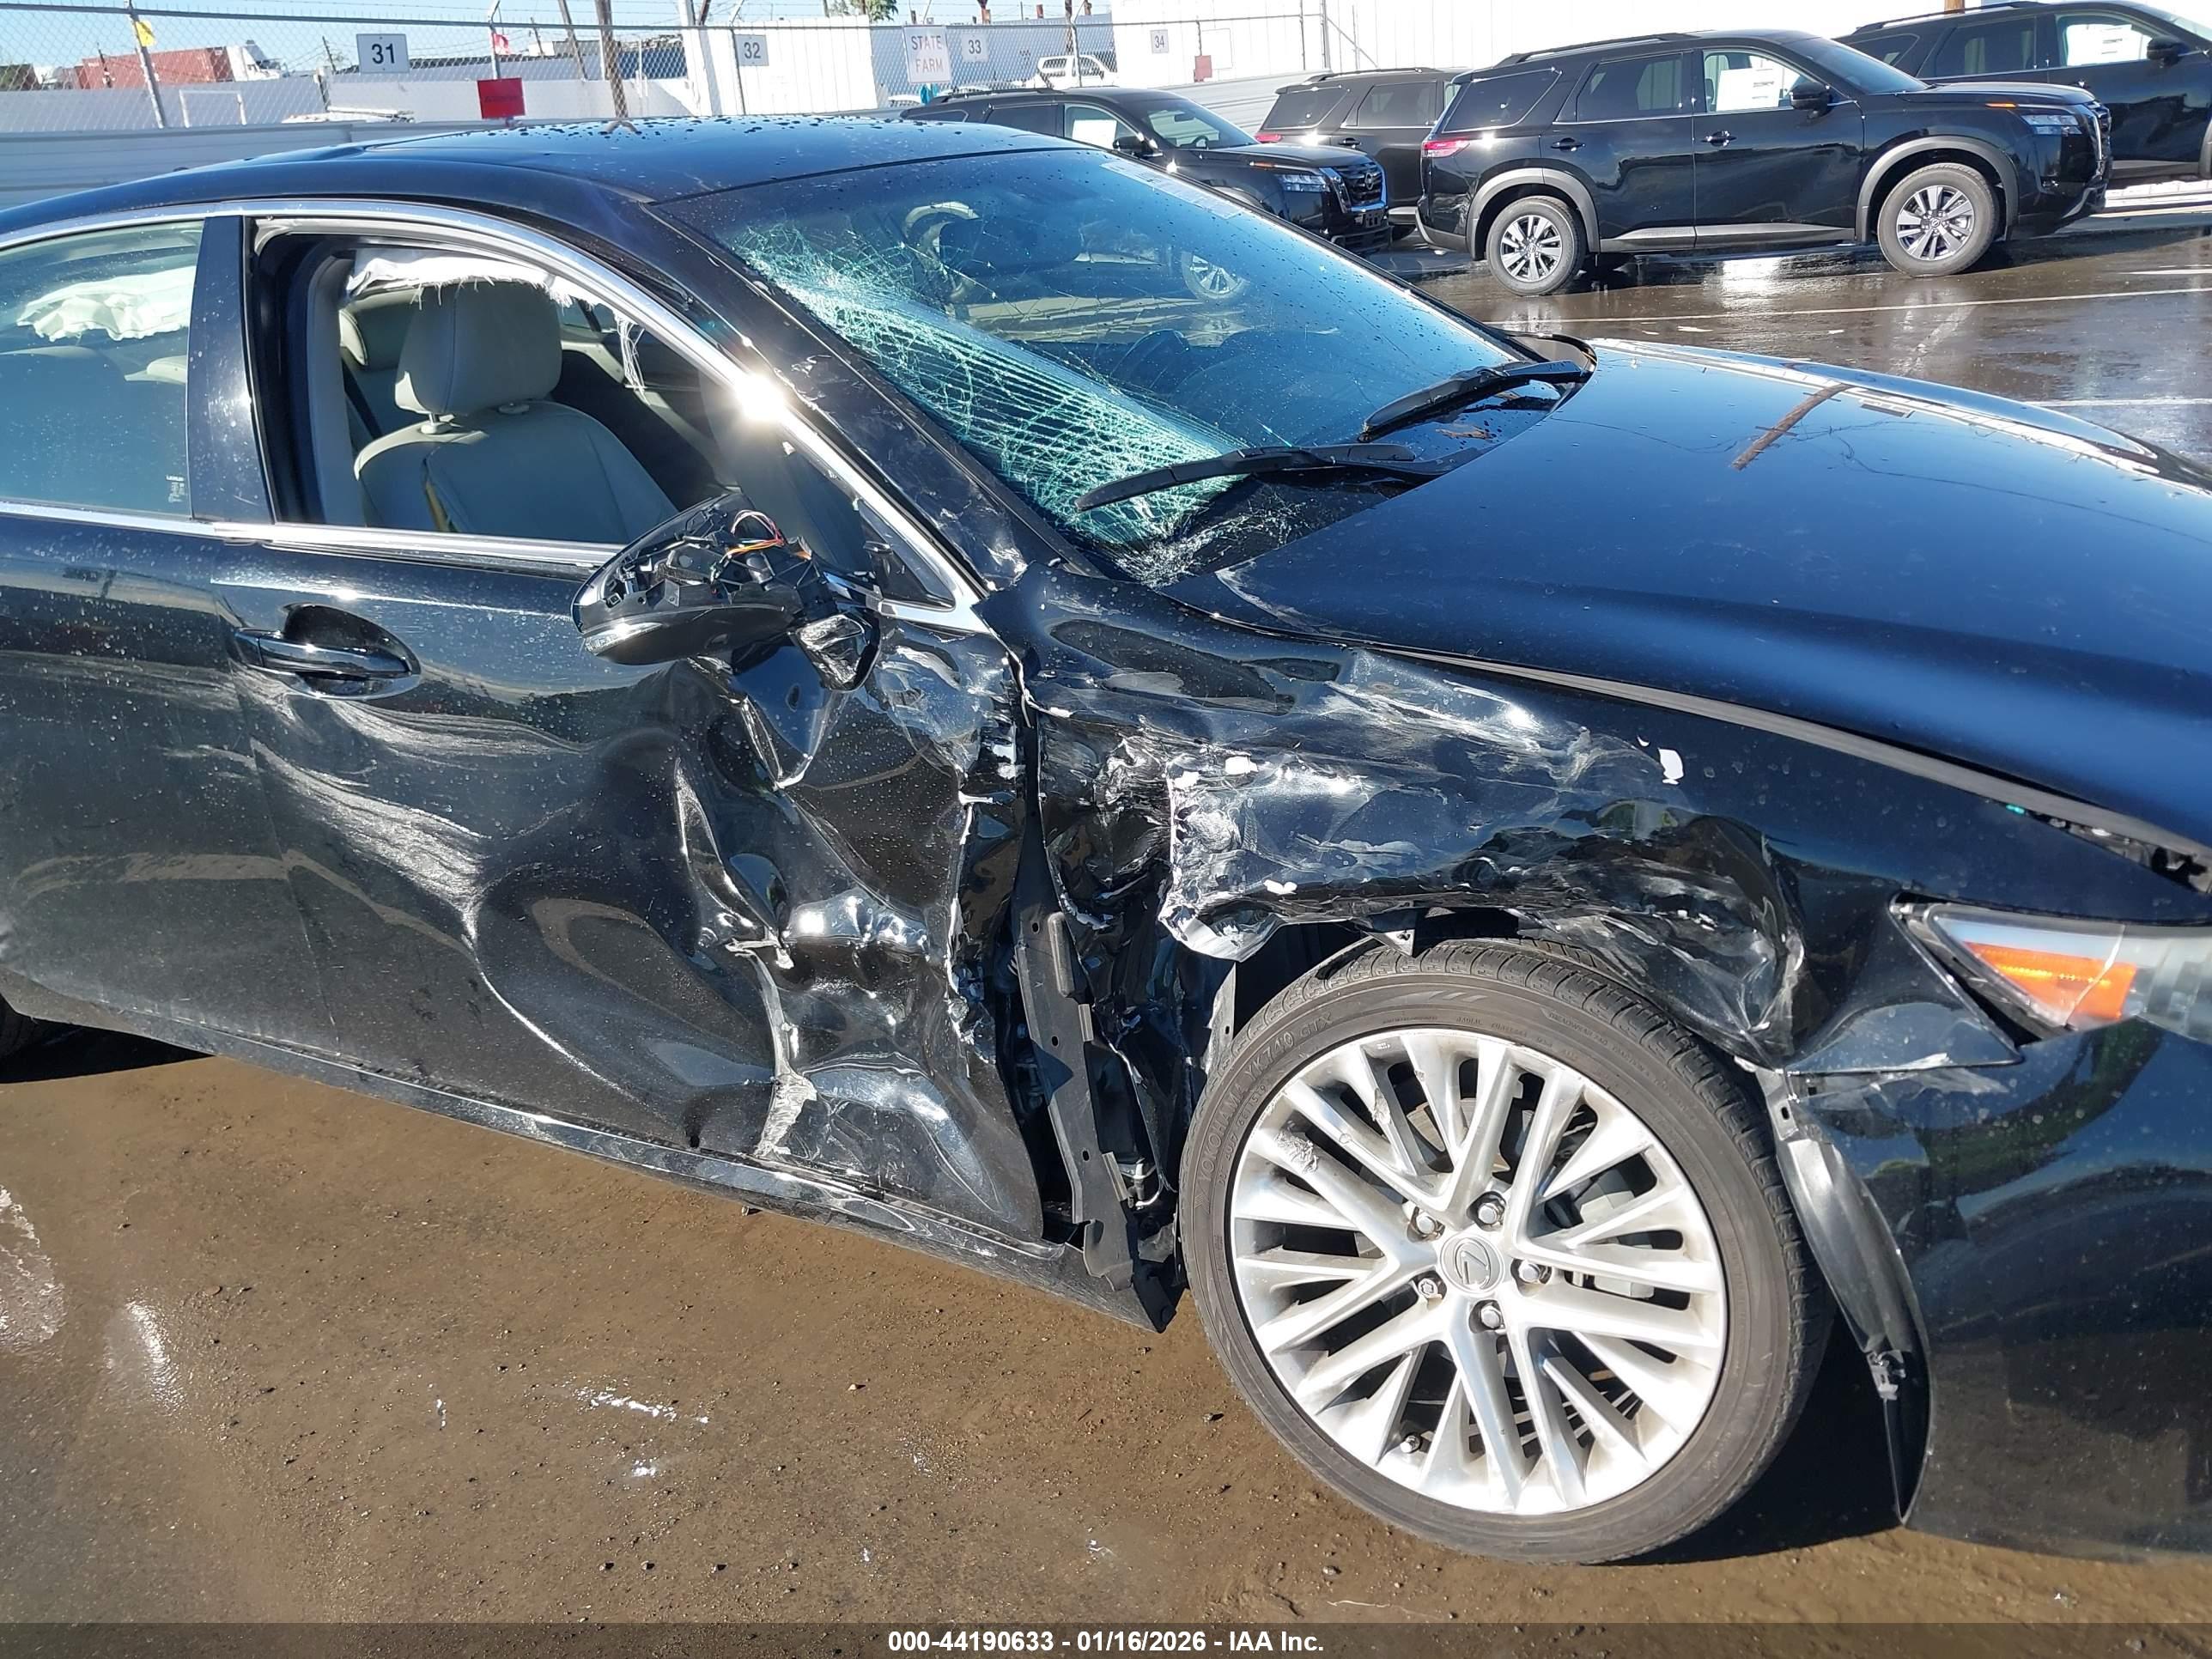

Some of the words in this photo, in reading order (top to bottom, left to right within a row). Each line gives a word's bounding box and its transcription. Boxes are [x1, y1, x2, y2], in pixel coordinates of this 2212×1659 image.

[744, 41, 762, 59] 32
[911, 35, 942, 51] STATE
[968, 40, 981, 54] 33
[1154, 35, 1165, 49] 34
[371, 43, 395, 64] 31
[915, 58, 944, 73] FARM
[1197, 1083, 1248, 1182] YOKOHAMA
[1245, 1031, 1295, 1082] YK740
